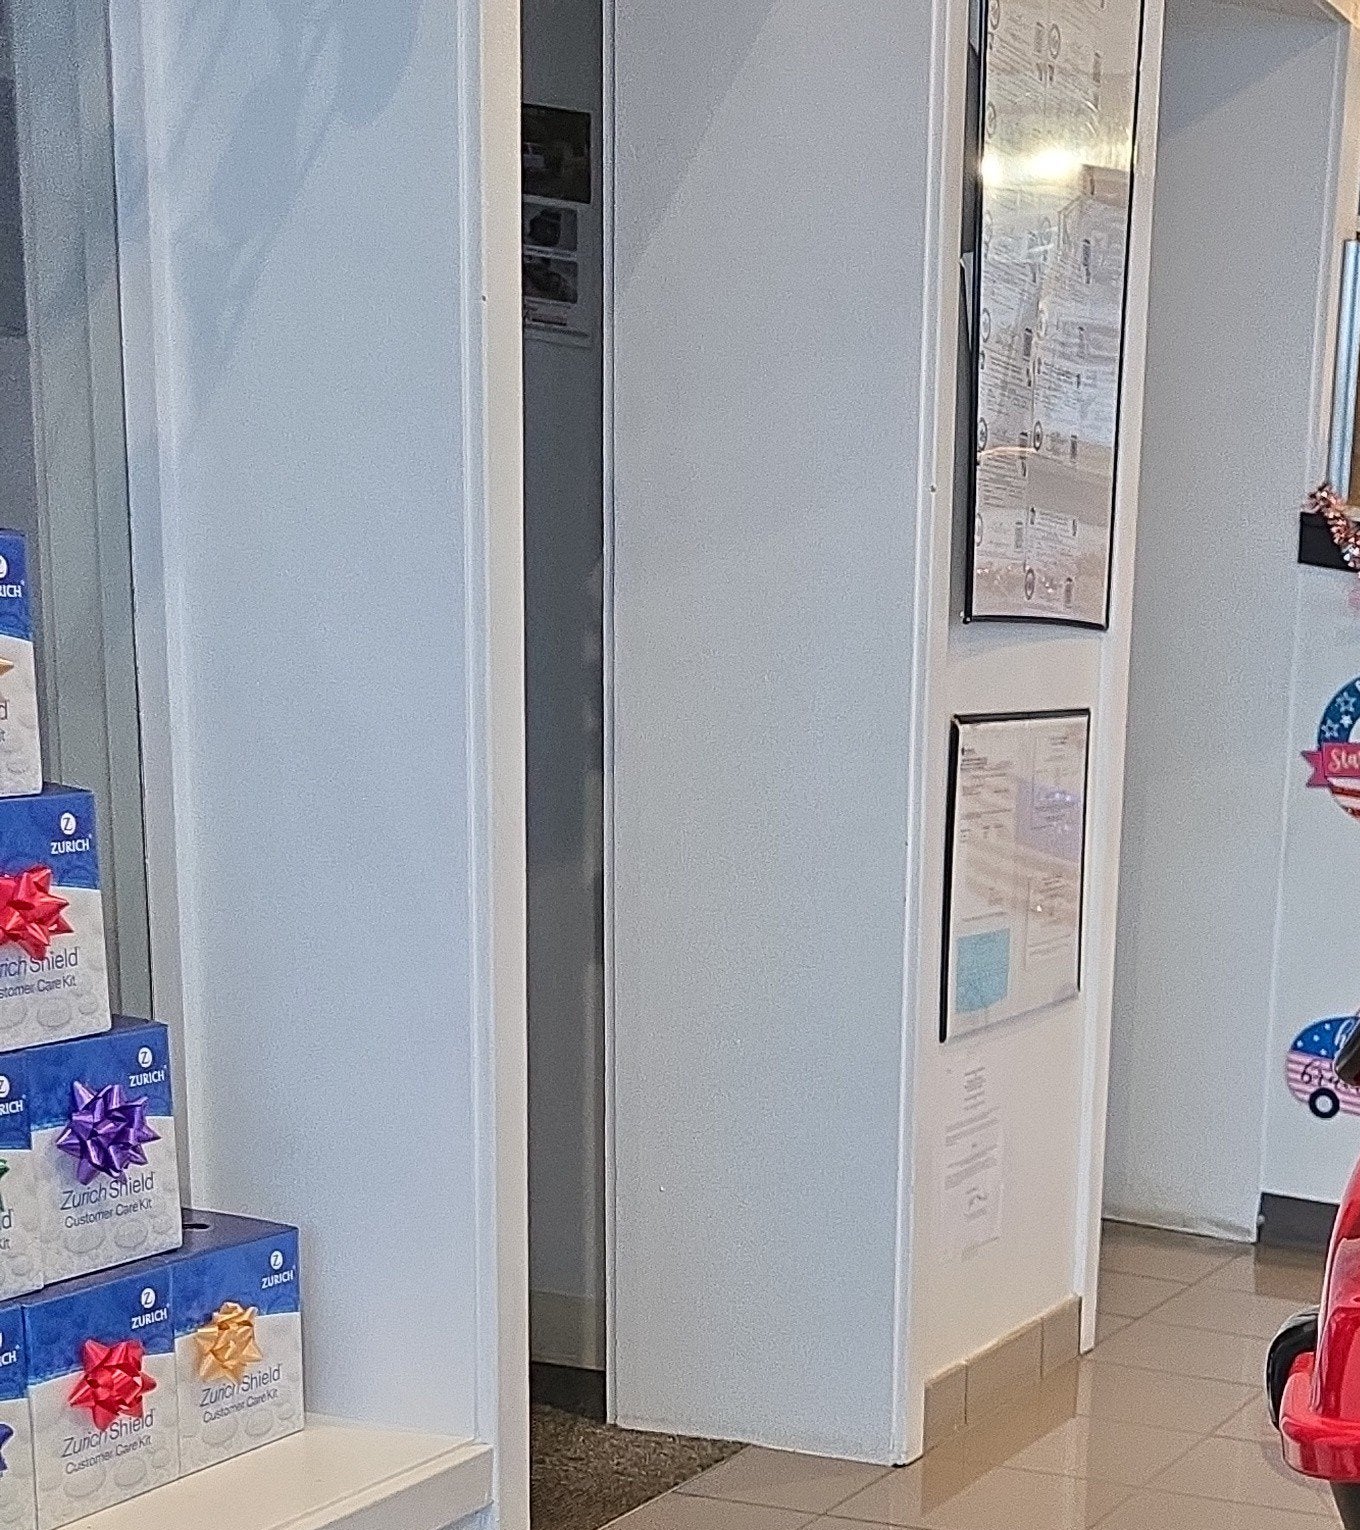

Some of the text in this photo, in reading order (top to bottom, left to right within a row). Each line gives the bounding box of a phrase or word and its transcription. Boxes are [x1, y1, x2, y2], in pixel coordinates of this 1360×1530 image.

[0, 584, 22, 598] RICH
[50, 838, 90, 855] ZURICH
[0, 946, 79, 977] rich Shield
[0, 983, 35, 999] stomer
[37, 978, 62, 992] Care
[129, 1069, 165, 1088] ZURICH
[0, 1099, 23, 1116] RICH
[60, 1171, 155, 1211] Zurich Shield
[64, 1197, 153, 1229] Customer Care Kit
[261, 1269, 294, 1290] ZURICH
[131, 1307, 168, 1330] ZURICH
[200, 1362, 281, 1407] Zurich Shield
[203, 1401, 245, 1423] Customer
[61, 1408, 155, 1458] Zurich Shield
[65, 1451, 113, 1475] Customer
[115, 1441, 139, 1456] Care
